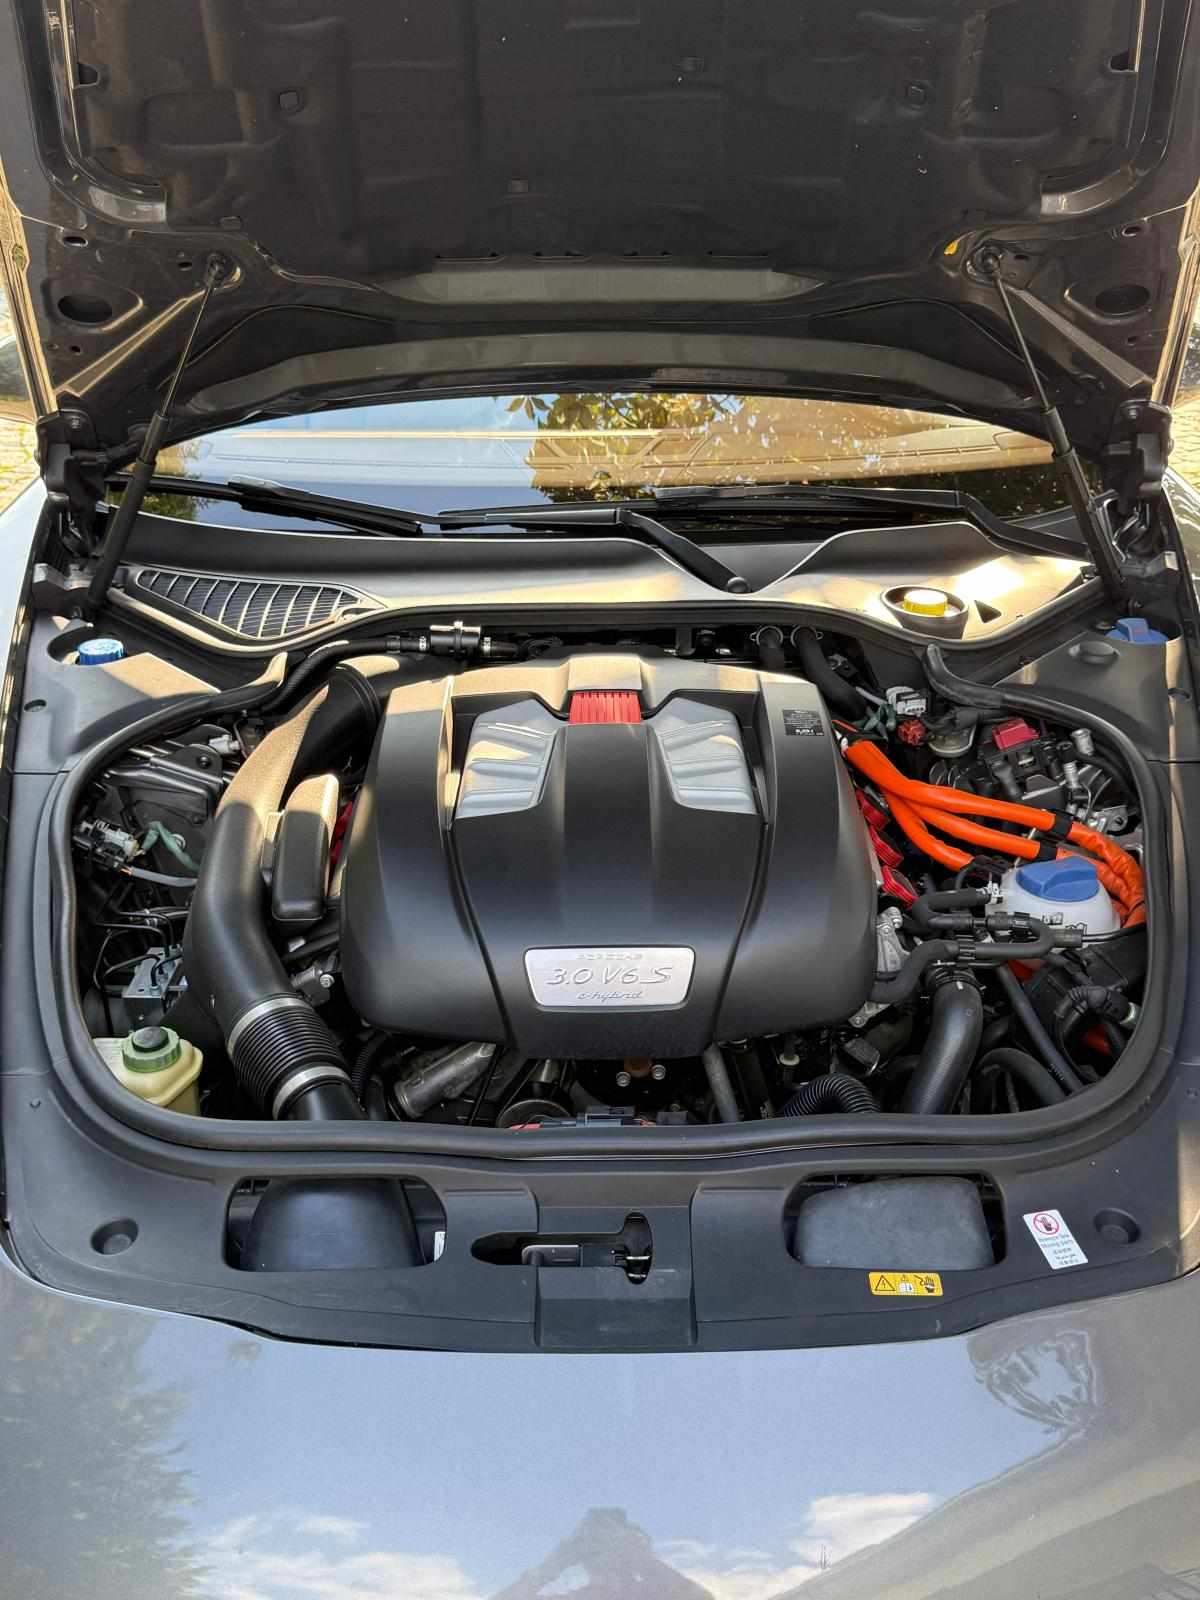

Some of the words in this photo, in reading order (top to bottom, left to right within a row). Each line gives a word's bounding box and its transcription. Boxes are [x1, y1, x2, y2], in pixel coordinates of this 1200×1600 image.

[546, 968, 593, 985] 3.0
[602, 967, 639, 985] V6
[640, 967, 673, 984] S
